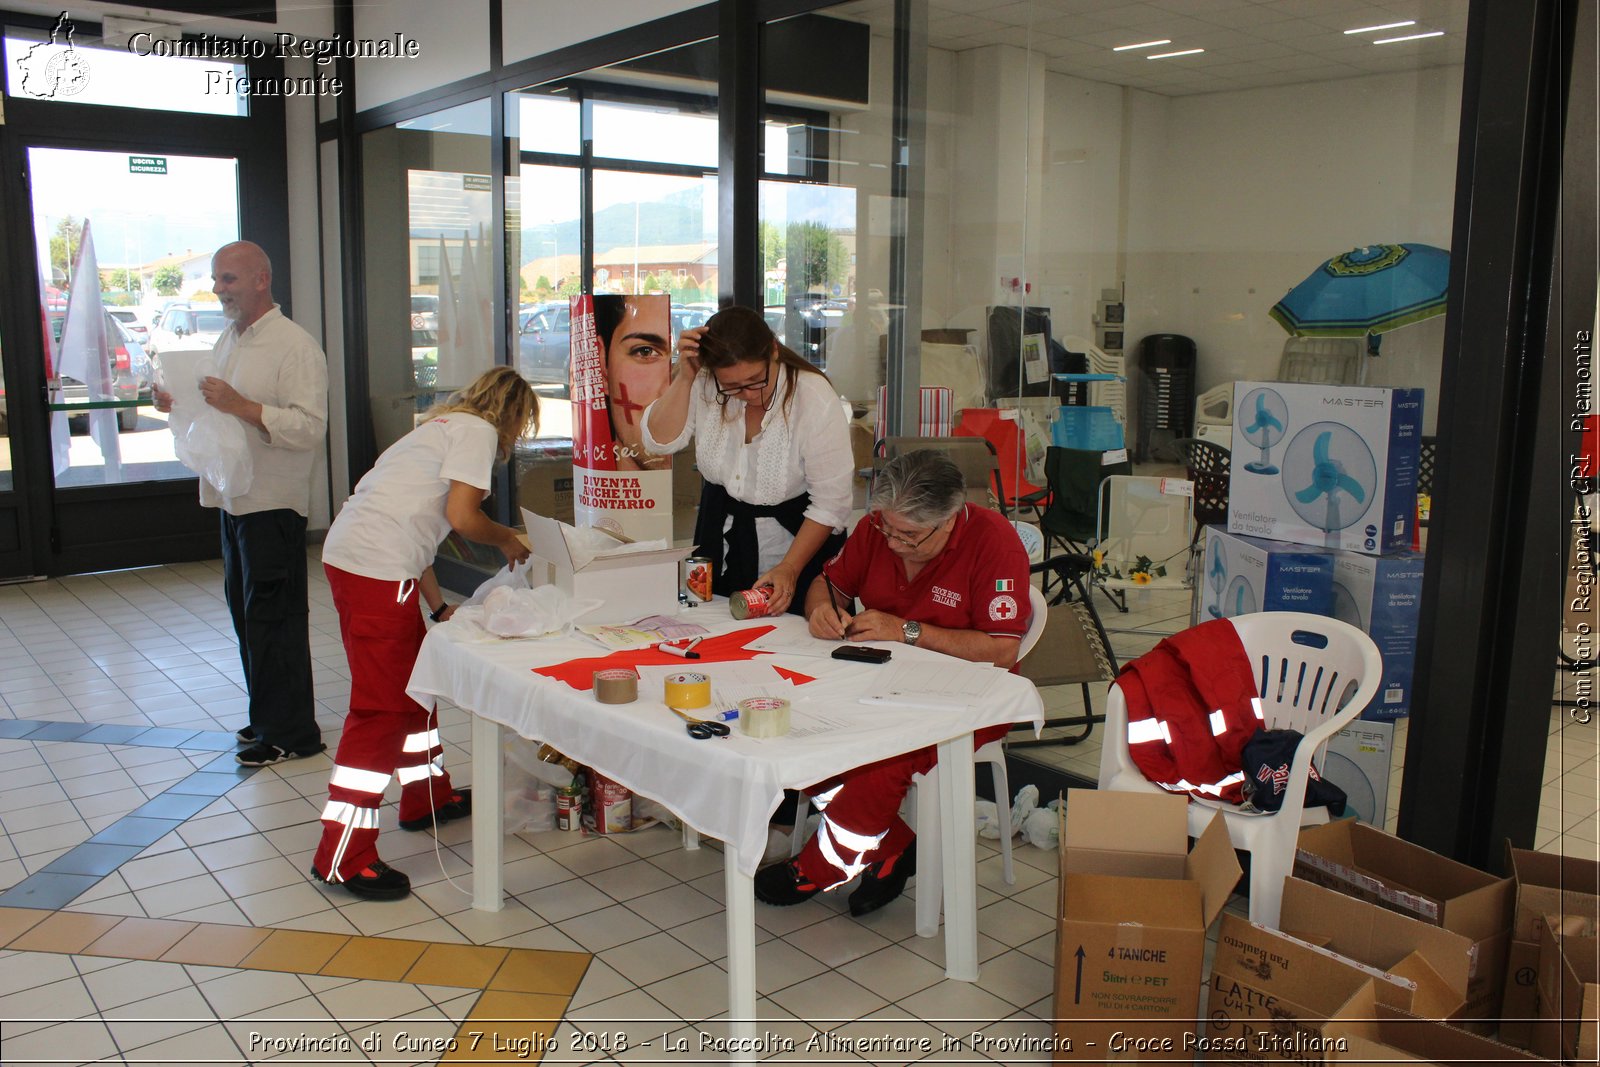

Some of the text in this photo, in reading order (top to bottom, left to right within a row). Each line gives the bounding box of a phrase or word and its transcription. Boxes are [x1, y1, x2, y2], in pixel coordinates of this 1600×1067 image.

[130, 165, 166, 173] SICUREZZA
[592, 398, 607, 410] di
[1322, 397, 1385, 409] MASTER
[583, 475, 641, 488] DIVENTA
[582, 485, 622, 499] ANCHE
[624, 488, 641, 499] TU
[578, 494, 656, 510] VOLONTARIO
[1232, 509, 1277, 524] Ventilatore
[1231, 521, 1272, 535] da tavolo
[931, 585, 948, 597] CROCE
[1281, 593, 1310, 601] da tavolo
[1282, 587, 1313, 595] Ventilatore
[932, 593, 957, 608] ITALIANA
[1108, 947, 1167, 963] 4 TANICHE
[1223, 936, 1290, 970] Pan Bauletto
[1102, 970, 1127, 984] 5litri
[1144, 976, 1169, 987] PET
[1091, 991, 1177, 1005] NON SOVRAPPORRE
[1214, 975, 1279, 1011] LATTE
[1114, 1002, 1123, 1010] DI
[1131, 1003, 1169, 1013] CARTONI
[1223, 997, 1255, 1017] UHT
